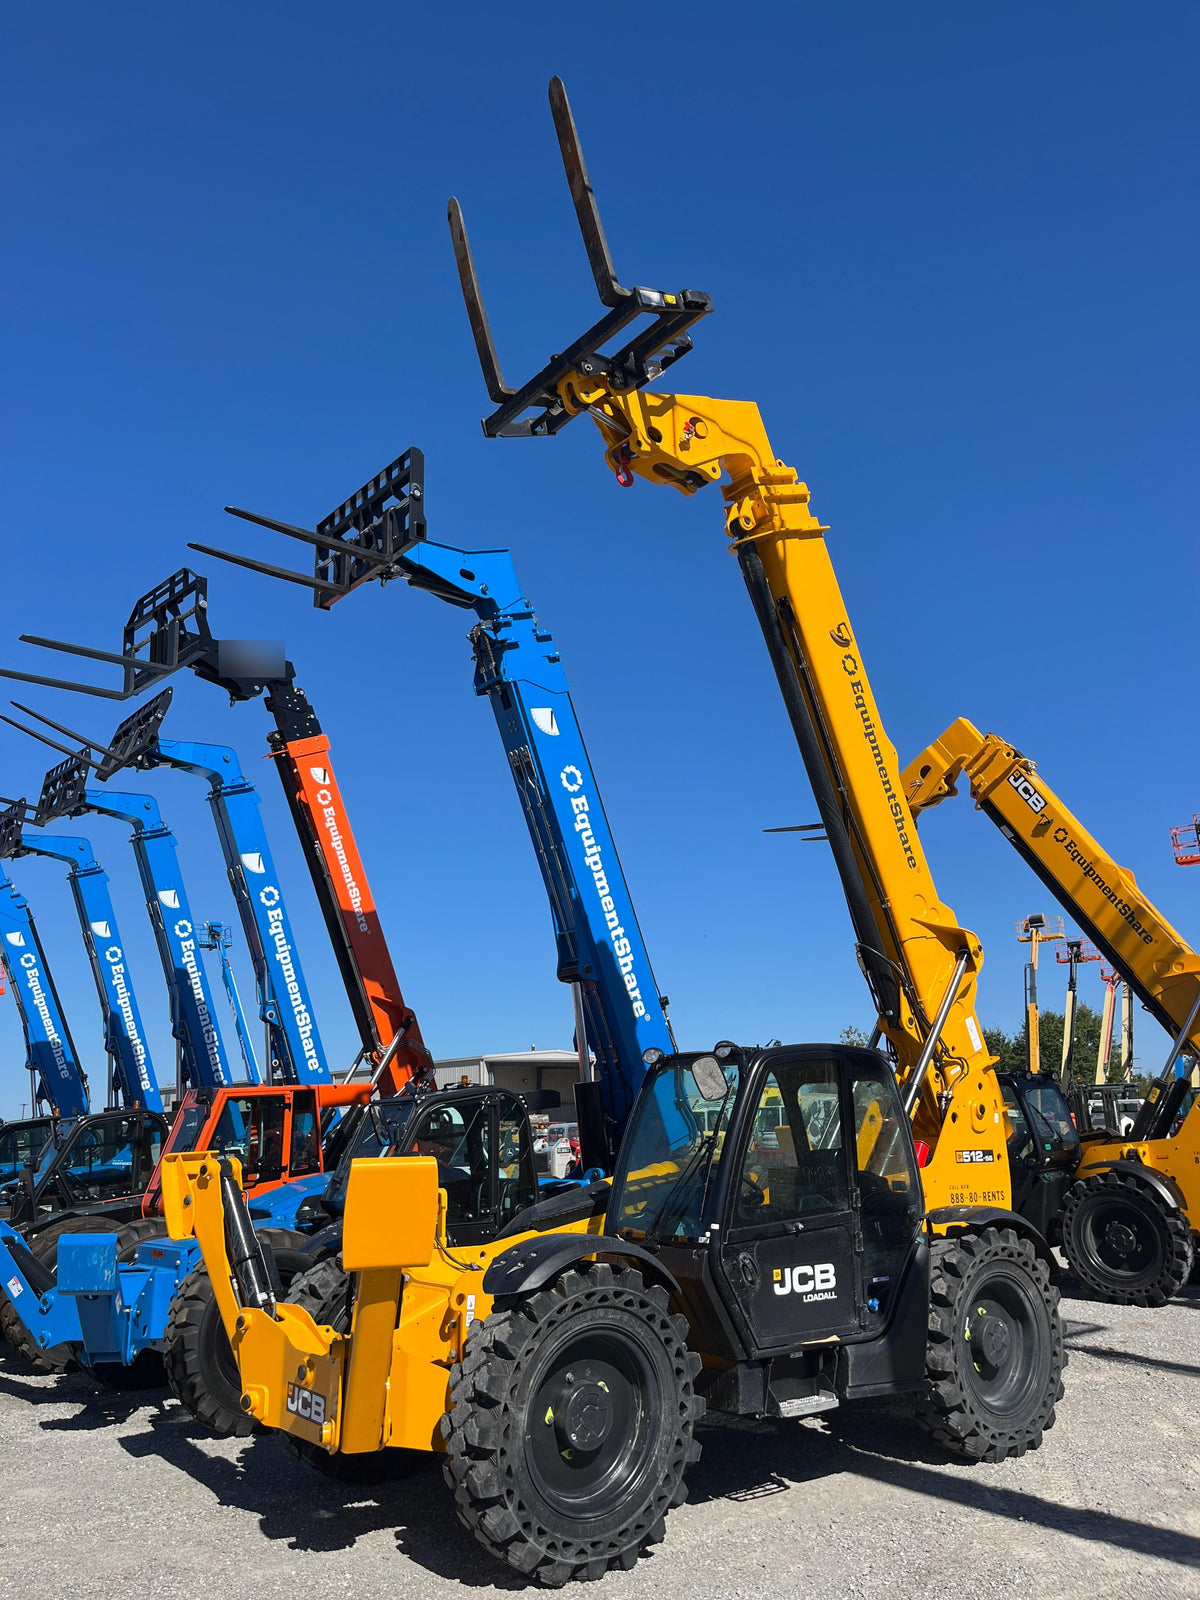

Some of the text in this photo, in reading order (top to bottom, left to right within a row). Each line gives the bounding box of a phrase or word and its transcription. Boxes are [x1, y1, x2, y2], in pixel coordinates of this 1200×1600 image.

[1008, 773, 1046, 812] JCB
[950, 1190, 1005, 1204] 888-80-RENTS
[773, 1263, 837, 1296] JCB
[803, 1291, 838, 1303] LOADALL
[287, 1386, 325, 1424] JCB
